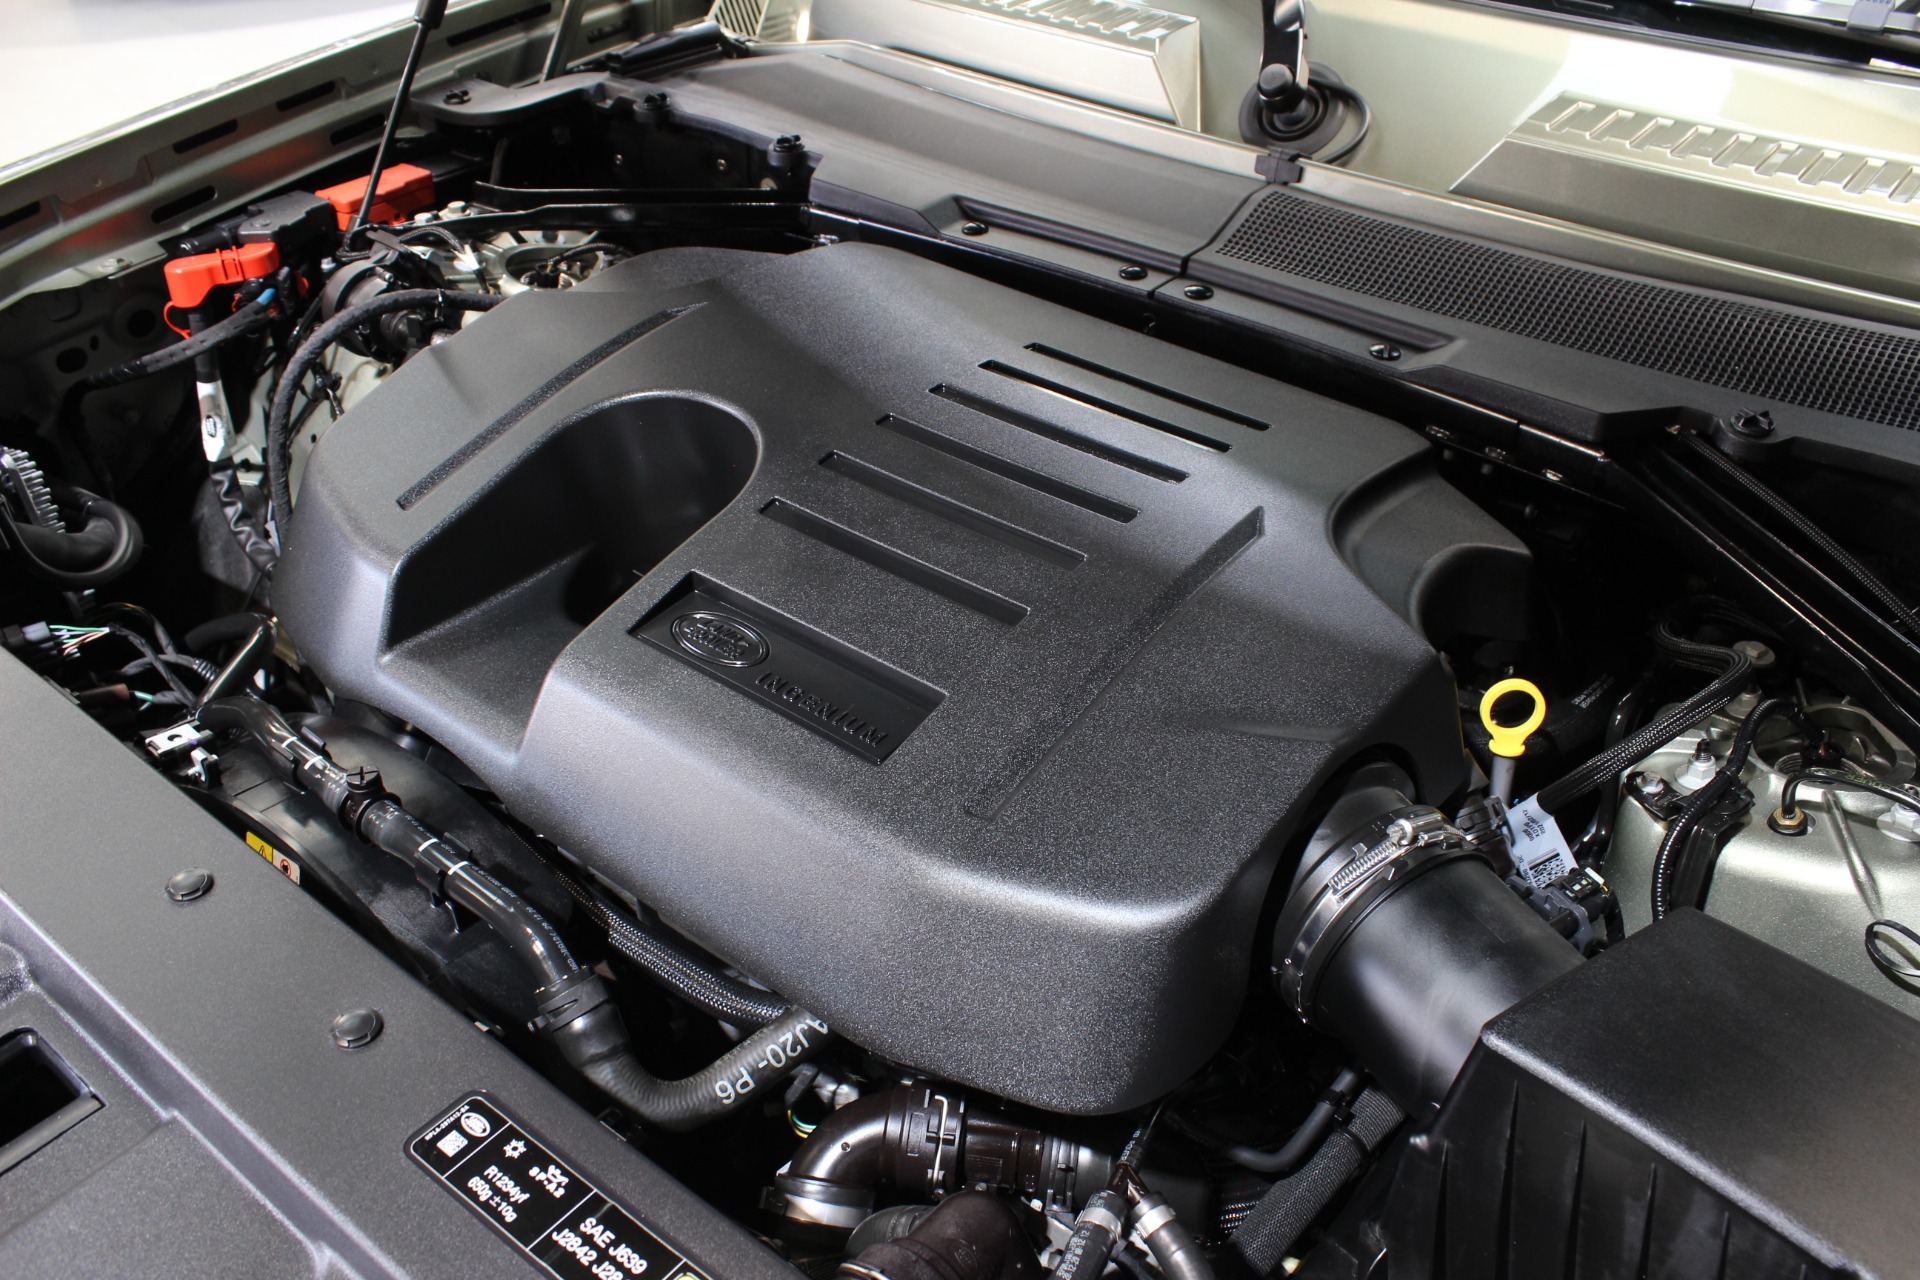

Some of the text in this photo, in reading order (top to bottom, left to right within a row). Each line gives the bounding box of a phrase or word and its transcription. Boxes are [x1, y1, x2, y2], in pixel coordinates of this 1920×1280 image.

[754, 671, 890, 748] INGENIUM
[467, 1175, 492, 1202] 650g
[483, 1164, 531, 1205] R1234yf
[551, 1228, 598, 1266] J2842
[579, 1216, 649, 1275] SAE J639
